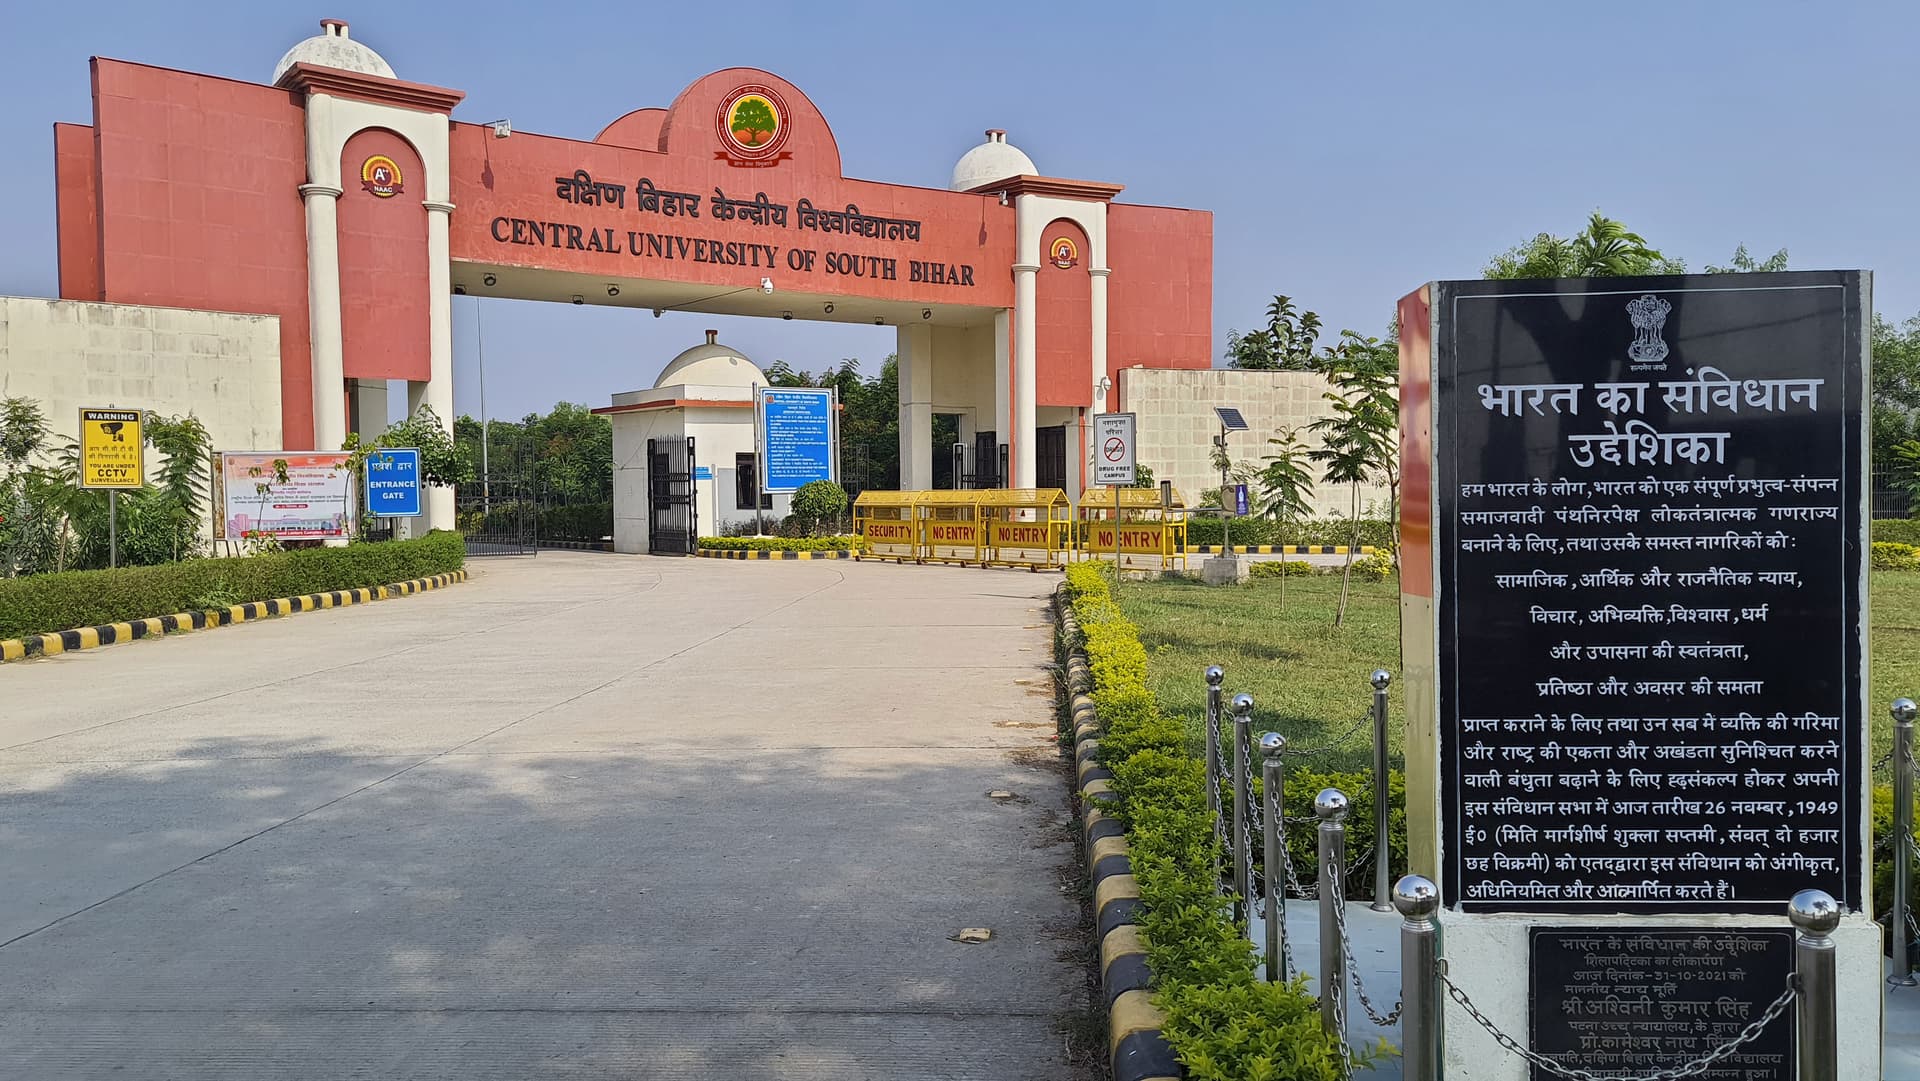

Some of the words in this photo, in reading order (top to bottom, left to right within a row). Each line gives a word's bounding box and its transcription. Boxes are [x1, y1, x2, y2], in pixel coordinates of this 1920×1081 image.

[555, 169, 626, 209] दक्षिण
[636, 177, 701, 218] बिहार
[711, 187, 788, 228] केन्द्रीय
[797, 198, 921, 243] विश्वविद्यालय
[491, 216, 621, 254] CENTRAL
[627, 231, 779, 268] UNIVERSITY
[787, 249, 817, 272] OF
[825, 252, 897, 281] SOUTH
[909, 260, 975, 287] BIHAR
[1478, 383, 1583, 416] भारत
[1595, 382, 1650, 415] का
[1659, 366, 1824, 413] संविधान
[87, 412, 135, 420] WARNING
[1568, 419, 1731, 468] उद्देशिका
[98, 469, 127, 477] CCTV
[370, 481, 416, 489] ENTRANCE
[1461, 483, 1487, 498] हम
[1488, 481, 1530, 497] भारत
[1532, 478, 1548, 496] के
[1638, 476, 1662, 496] को
[1663, 481, 1690, 497] एक
[1460, 506, 1545, 525] समाजवादी
[1554, 505, 1641, 524] पंथनिरपेक्ष
[1651, 504, 1758, 523] लोकतंत्रात्मक
[1768, 507, 1838, 522] गणराज्य
[869, 525, 912, 538] SECURITY
[933, 526, 944, 539] NO
[946, 526, 976, 540] ENTRY
[999, 527, 1010, 541] NO
[1013, 528, 1048, 543] ENTRY
[1099, 531, 1113, 546] NO
[1119, 532, 1161, 548] ENTRY
[1461, 534, 1505, 553] बनाने
[1506, 534, 1523, 552] के
[1601, 532, 1642, 551] उसके
[1645, 537, 1693, 551] समस्त
[1696, 531, 1763, 551] नागरिकों
[1580, 568, 1635, 588] आर्थिक
[1640, 566, 1672, 588] और
[1677, 567, 1753, 588] राजनैतिक
[1742, 603, 1769, 622] धर्म
[1550, 640, 1581, 660] और
[1587, 645, 1649, 660] उपासना
[1652, 640, 1674, 659] की
[1536, 677, 1594, 696] प्रतिष्ठा
[1597, 676, 1629, 696] और
[1634, 681, 1686, 696] अवसर
[1691, 676, 1713, 695] की
[1717, 681, 1764, 696] समता
[1462, 718, 1500, 733] प्राप्त
[1503, 713, 1547, 733] कराने
[1551, 713, 1566, 732] के
[1571, 712, 1603, 735] लिए
[1607, 718, 1639, 732] तथा
[1642, 718, 1668, 732] उन
[1671, 718, 1699, 733] सब
[1702, 712, 1717, 731] में
[1720, 712, 1762, 732] व्यक्ति
[1767, 712, 1789, 731] की
[1792, 711, 1840, 732] गरिमा
[1464, 741, 1495, 760] और
[1500, 746, 1535, 763] राष्ट्र
[1540, 741, 1562, 760] की
[1565, 746, 1612, 762] एकता
[1617, 740, 1650, 760] और
[1654, 741, 1717, 760] अखंडता
[1720, 740, 1796, 763] सुनिश्चित
[1800, 740, 1840, 760] करने
[1464, 769, 1503, 789] वाली
[1507, 769, 1553, 792] बंधुता
[1559, 769, 1602, 790] बढ़ाने
[1606, 769, 1622, 788] के
[1628, 768, 1662, 791] लिए
[1744, 768, 1786, 788] होकर
[1793, 768, 1840, 788] अपनी
[1465, 802, 1490, 818] इस
[1492, 797, 1555, 816] संविधान
[1558, 802, 1592, 816] सभा
[1595, 797, 1610, 815] में
[1612, 802, 1649, 815] आज
[1652, 797, 1703, 816] तारीख
[1705, 801, 1725, 815] 26
[1797, 801, 1839, 815] 1949
[1543, 824, 1608, 844] मार्गशीर्ष
[1614, 830, 1660, 848] शुक्ला
[1728, 824, 1769, 848] संवत्
[1775, 824, 1793, 843] दो
[1799, 830, 1840, 844] हजार
[1464, 858, 1490, 872] छह
[1555, 853, 1577, 871] को
[1650, 858, 1675, 875] इस
[1678, 852, 1742, 871] संविधान
[1745, 853, 1767, 871] को
[1467, 880, 1561, 899] अधिनियमित
[1563, 879, 1595, 899] और
[1675, 881, 1714, 899] करते
[1658, 1001, 1712, 1020] कुमार
[1715, 996, 1752, 1020] सिंह
